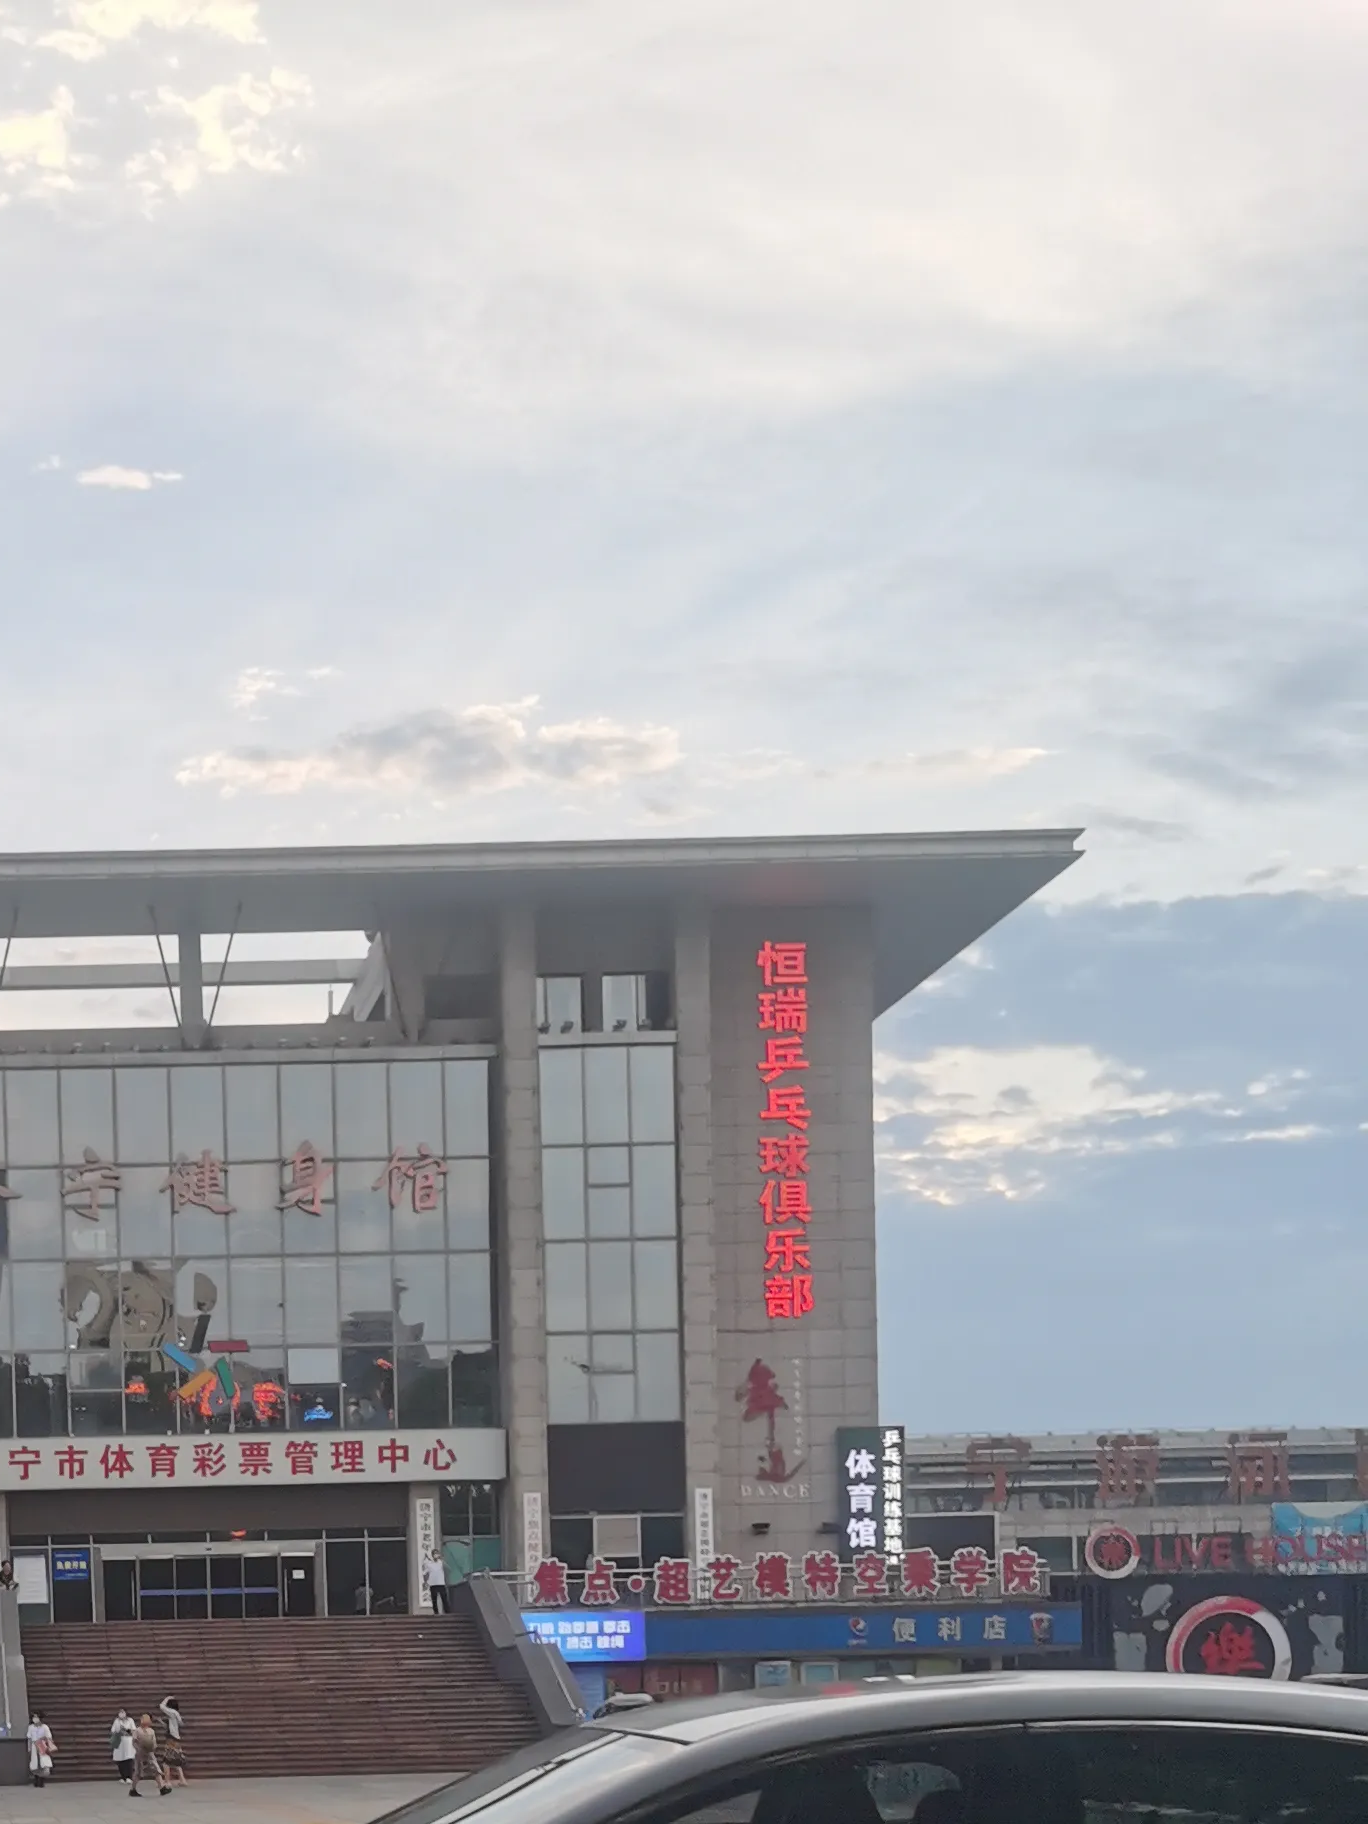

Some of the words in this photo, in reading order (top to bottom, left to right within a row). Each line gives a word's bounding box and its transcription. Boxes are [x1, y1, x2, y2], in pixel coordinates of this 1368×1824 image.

[756, 940, 815, 1318] 恒瑞乒乓球俱乐部
[845, 1448, 877, 1548] 体育馆
[1153, 1535, 1233, 1570] LIVE
[892, 1614, 1007, 1643] 便利店
